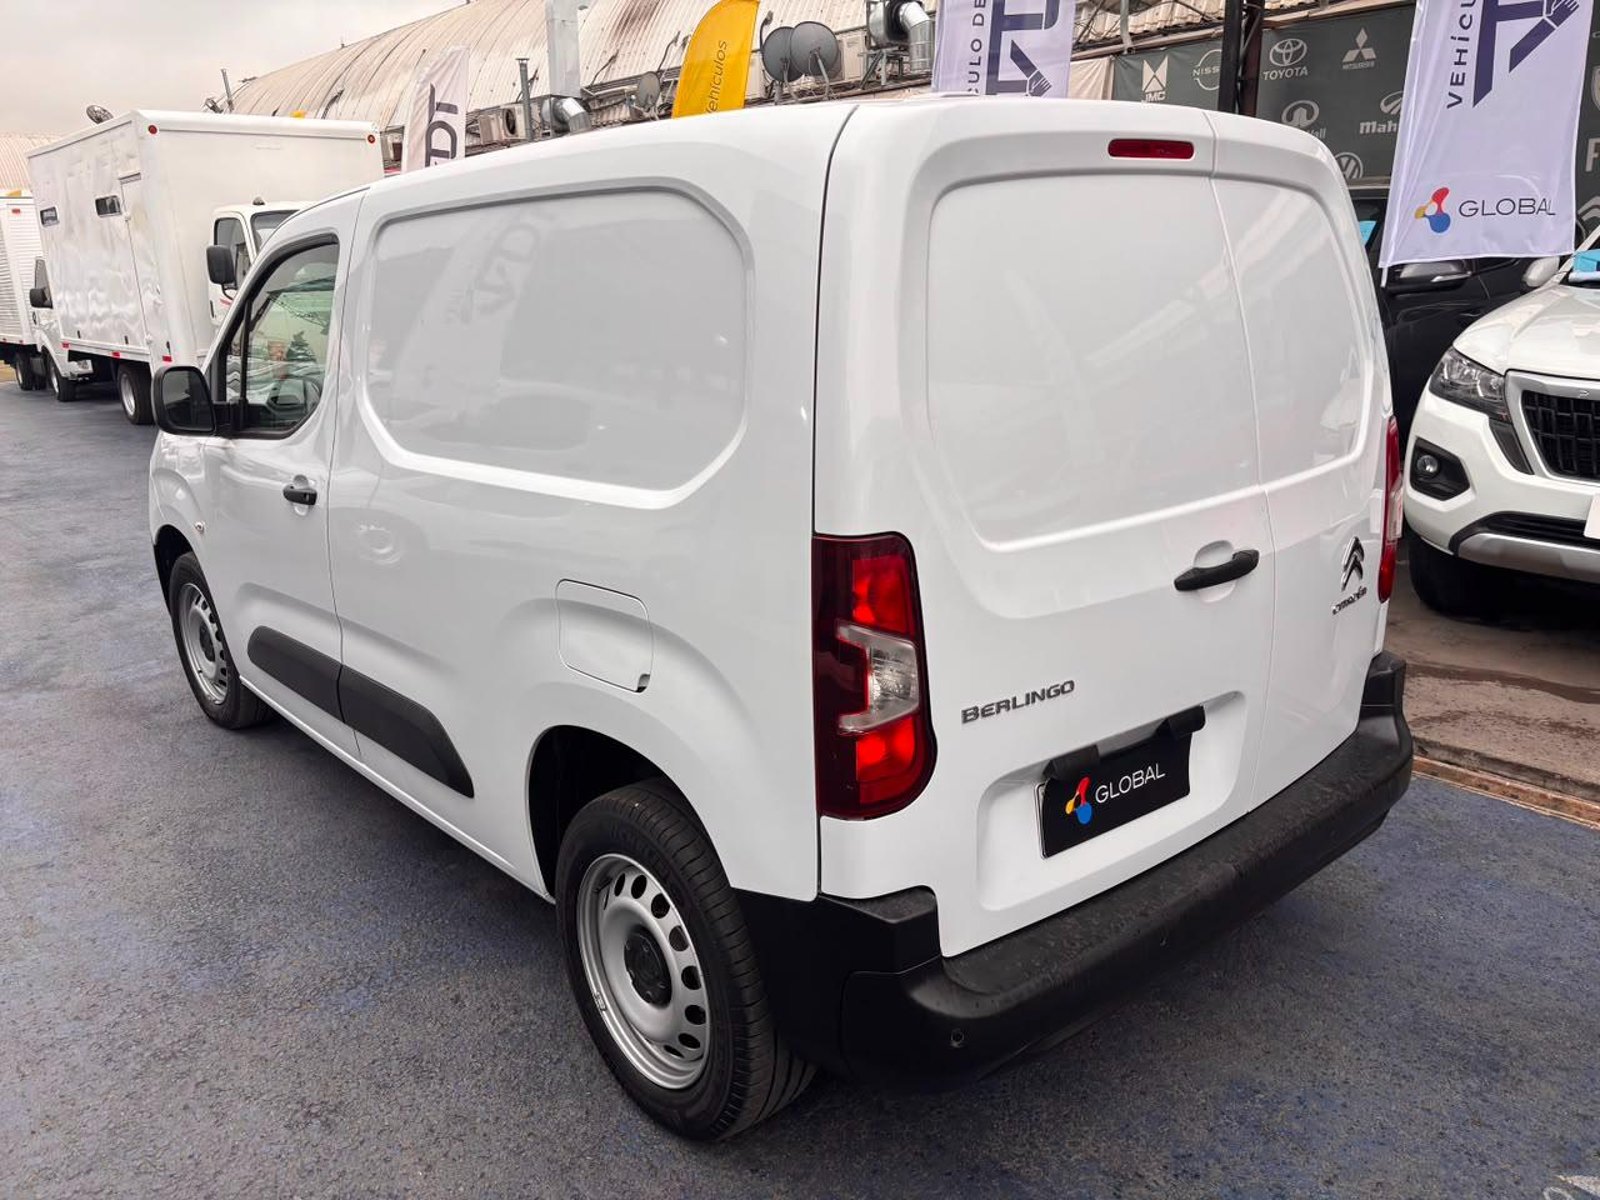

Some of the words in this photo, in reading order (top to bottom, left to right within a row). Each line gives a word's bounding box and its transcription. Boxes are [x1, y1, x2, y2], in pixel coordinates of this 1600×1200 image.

[1263, 66, 1308, 80] TOYOTA
[1458, 198, 1556, 217] GLOBAL
[961, 679, 1075, 724] BERLINGO
[1095, 763, 1166, 803] GLOBAL
